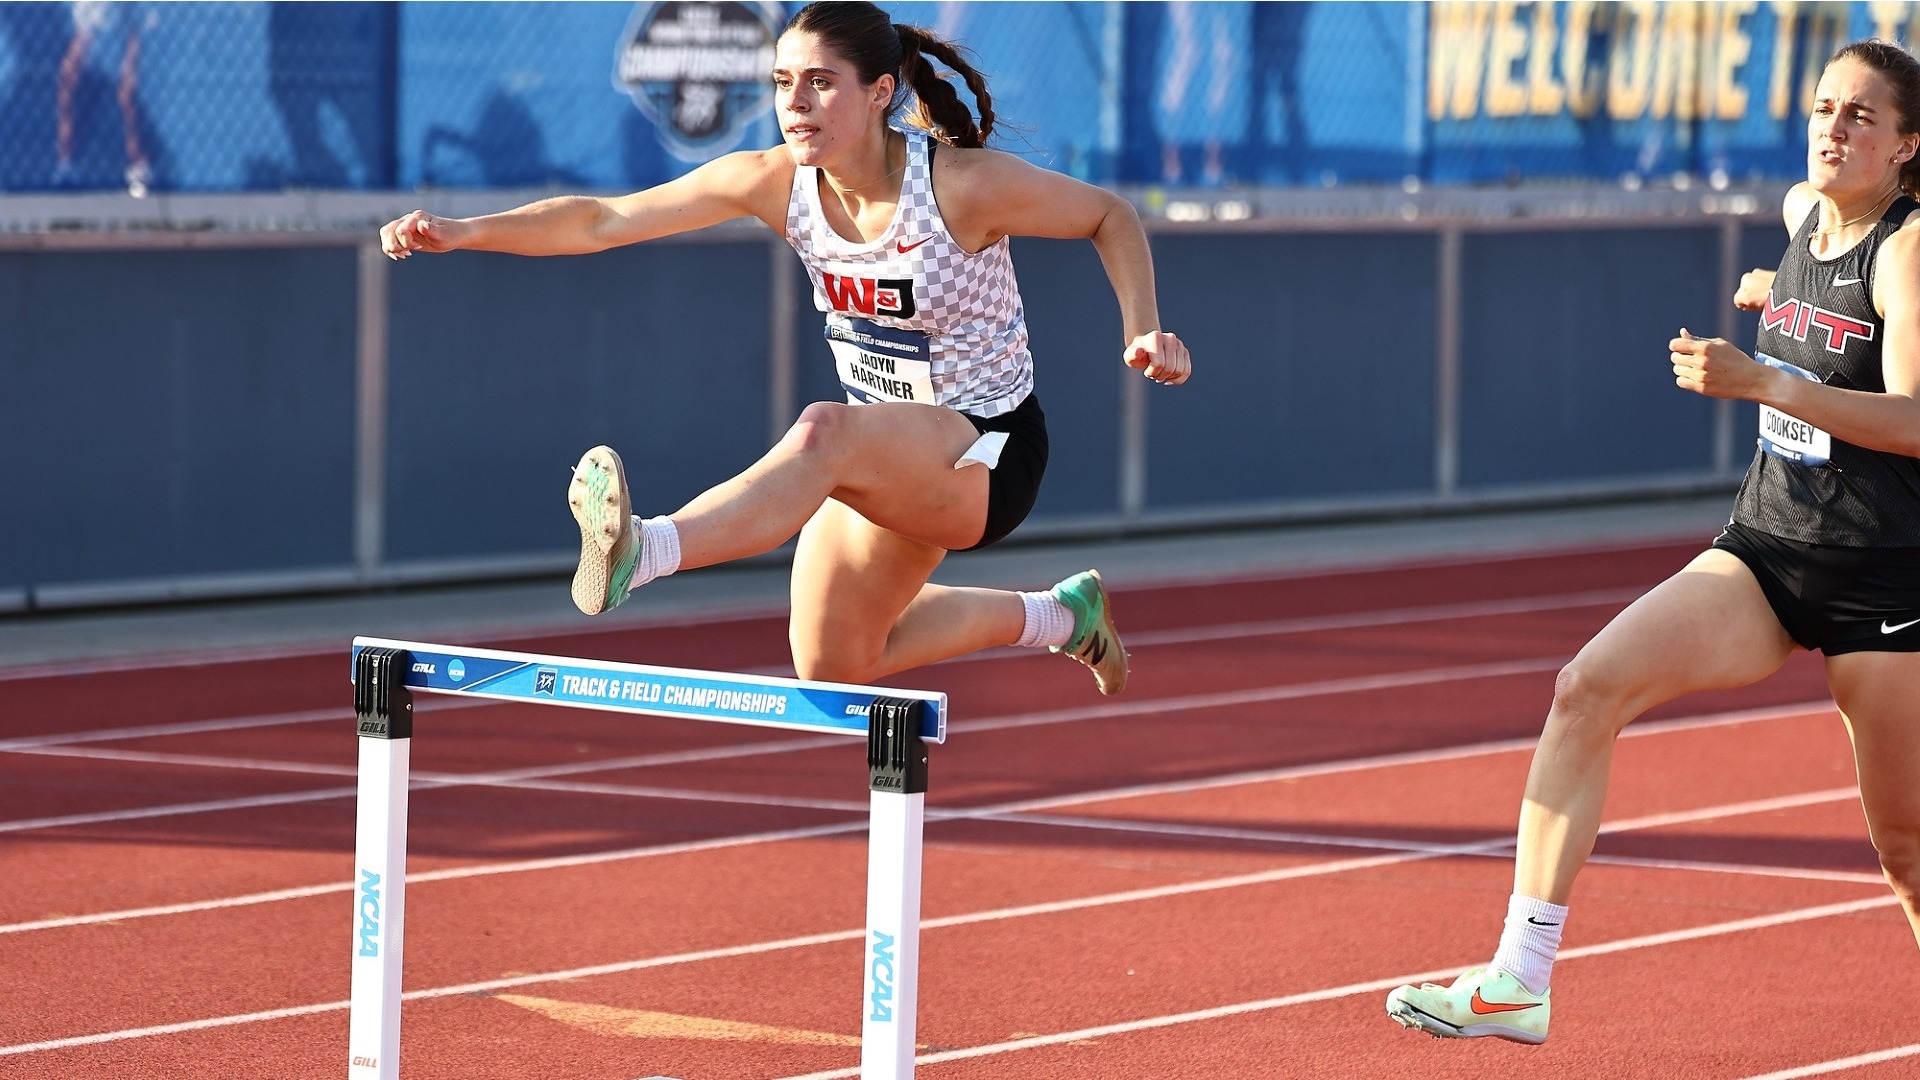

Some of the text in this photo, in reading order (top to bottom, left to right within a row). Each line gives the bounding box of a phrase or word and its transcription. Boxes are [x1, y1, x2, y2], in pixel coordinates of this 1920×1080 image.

[1428, 1, 1757, 119] WELCOME
[1759, 288, 1875, 355] MIT
[858, 351, 896, 375] JADYN
[874, 339, 920, 354] CHAMPIONSHIPS
[850, 362, 915, 401] HARTNER
[1766, 410, 1816, 445] COOKSEY
[411, 662, 436, 674] GILL
[561, 674, 788, 716] TRACK & FIELD CHAMPIONSHIPS
[360, 721, 387, 734] GILL
[872, 775, 903, 789] GILL
[359, 869, 381, 957] NCAA
[870, 929, 895, 1022] NCAA
[352, 1055, 378, 1068] GILL
